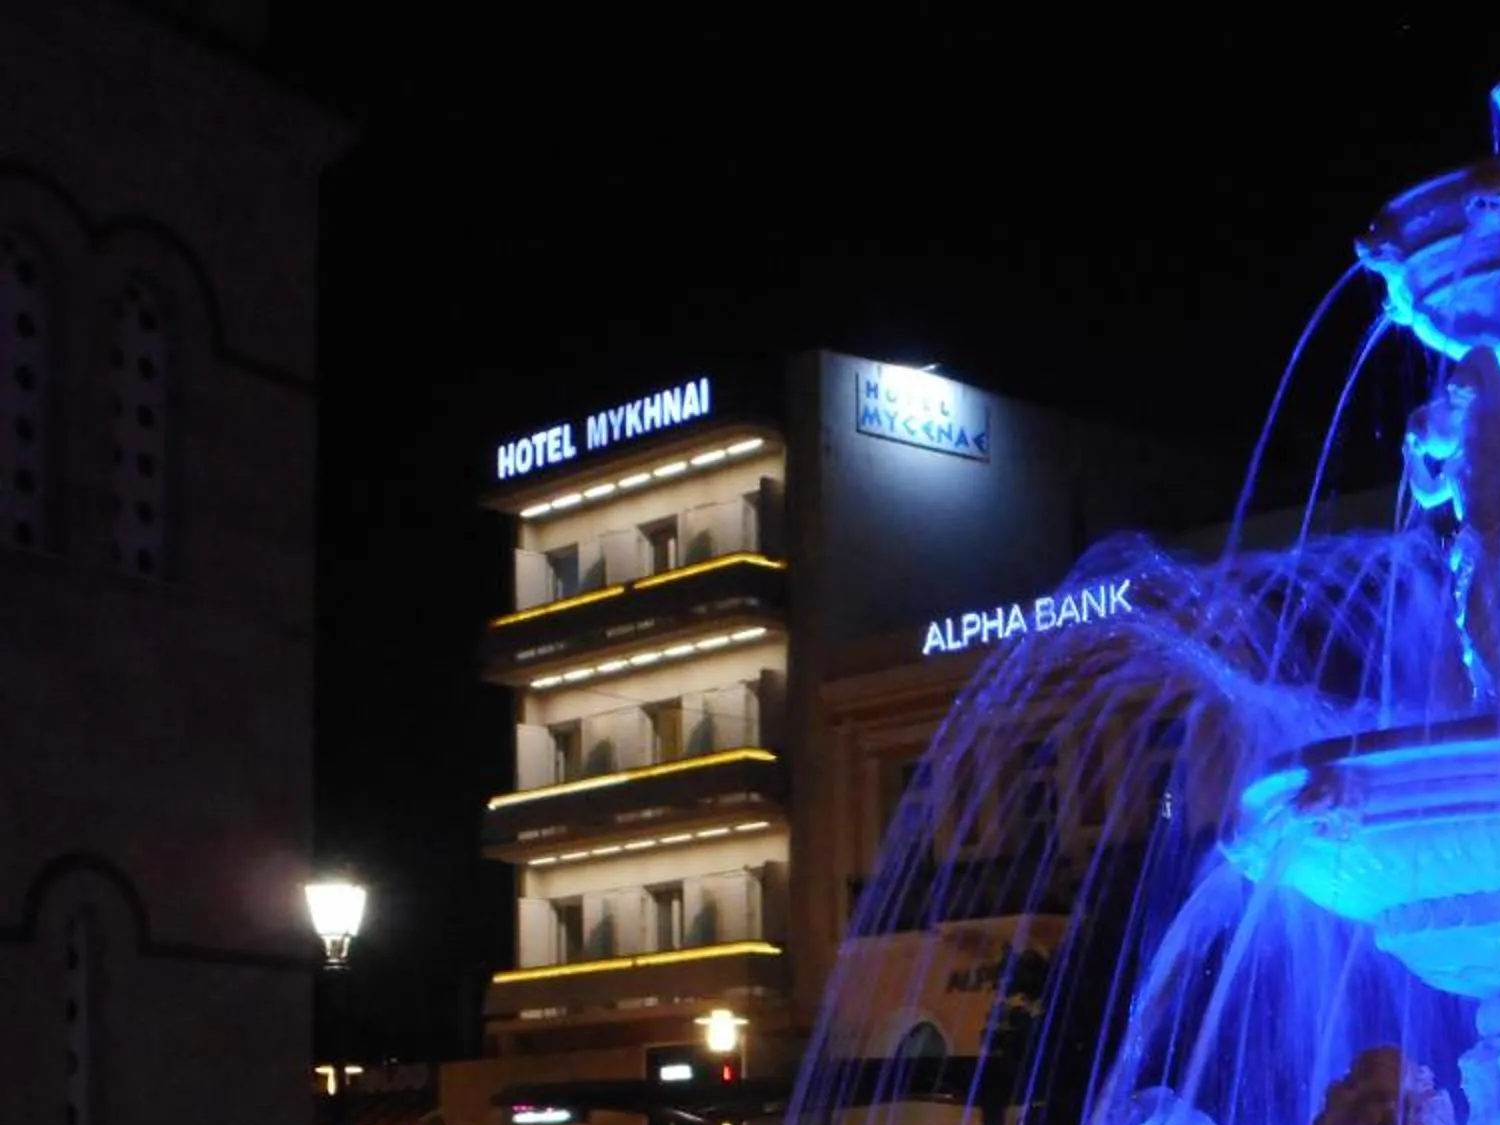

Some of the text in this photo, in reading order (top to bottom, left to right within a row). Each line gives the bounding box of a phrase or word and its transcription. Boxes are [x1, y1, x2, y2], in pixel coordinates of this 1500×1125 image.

[864, 380, 950, 417] HOL
[497, 424, 576, 479] HOTEL
[921, 578, 1133, 656] ALPHA BANK
